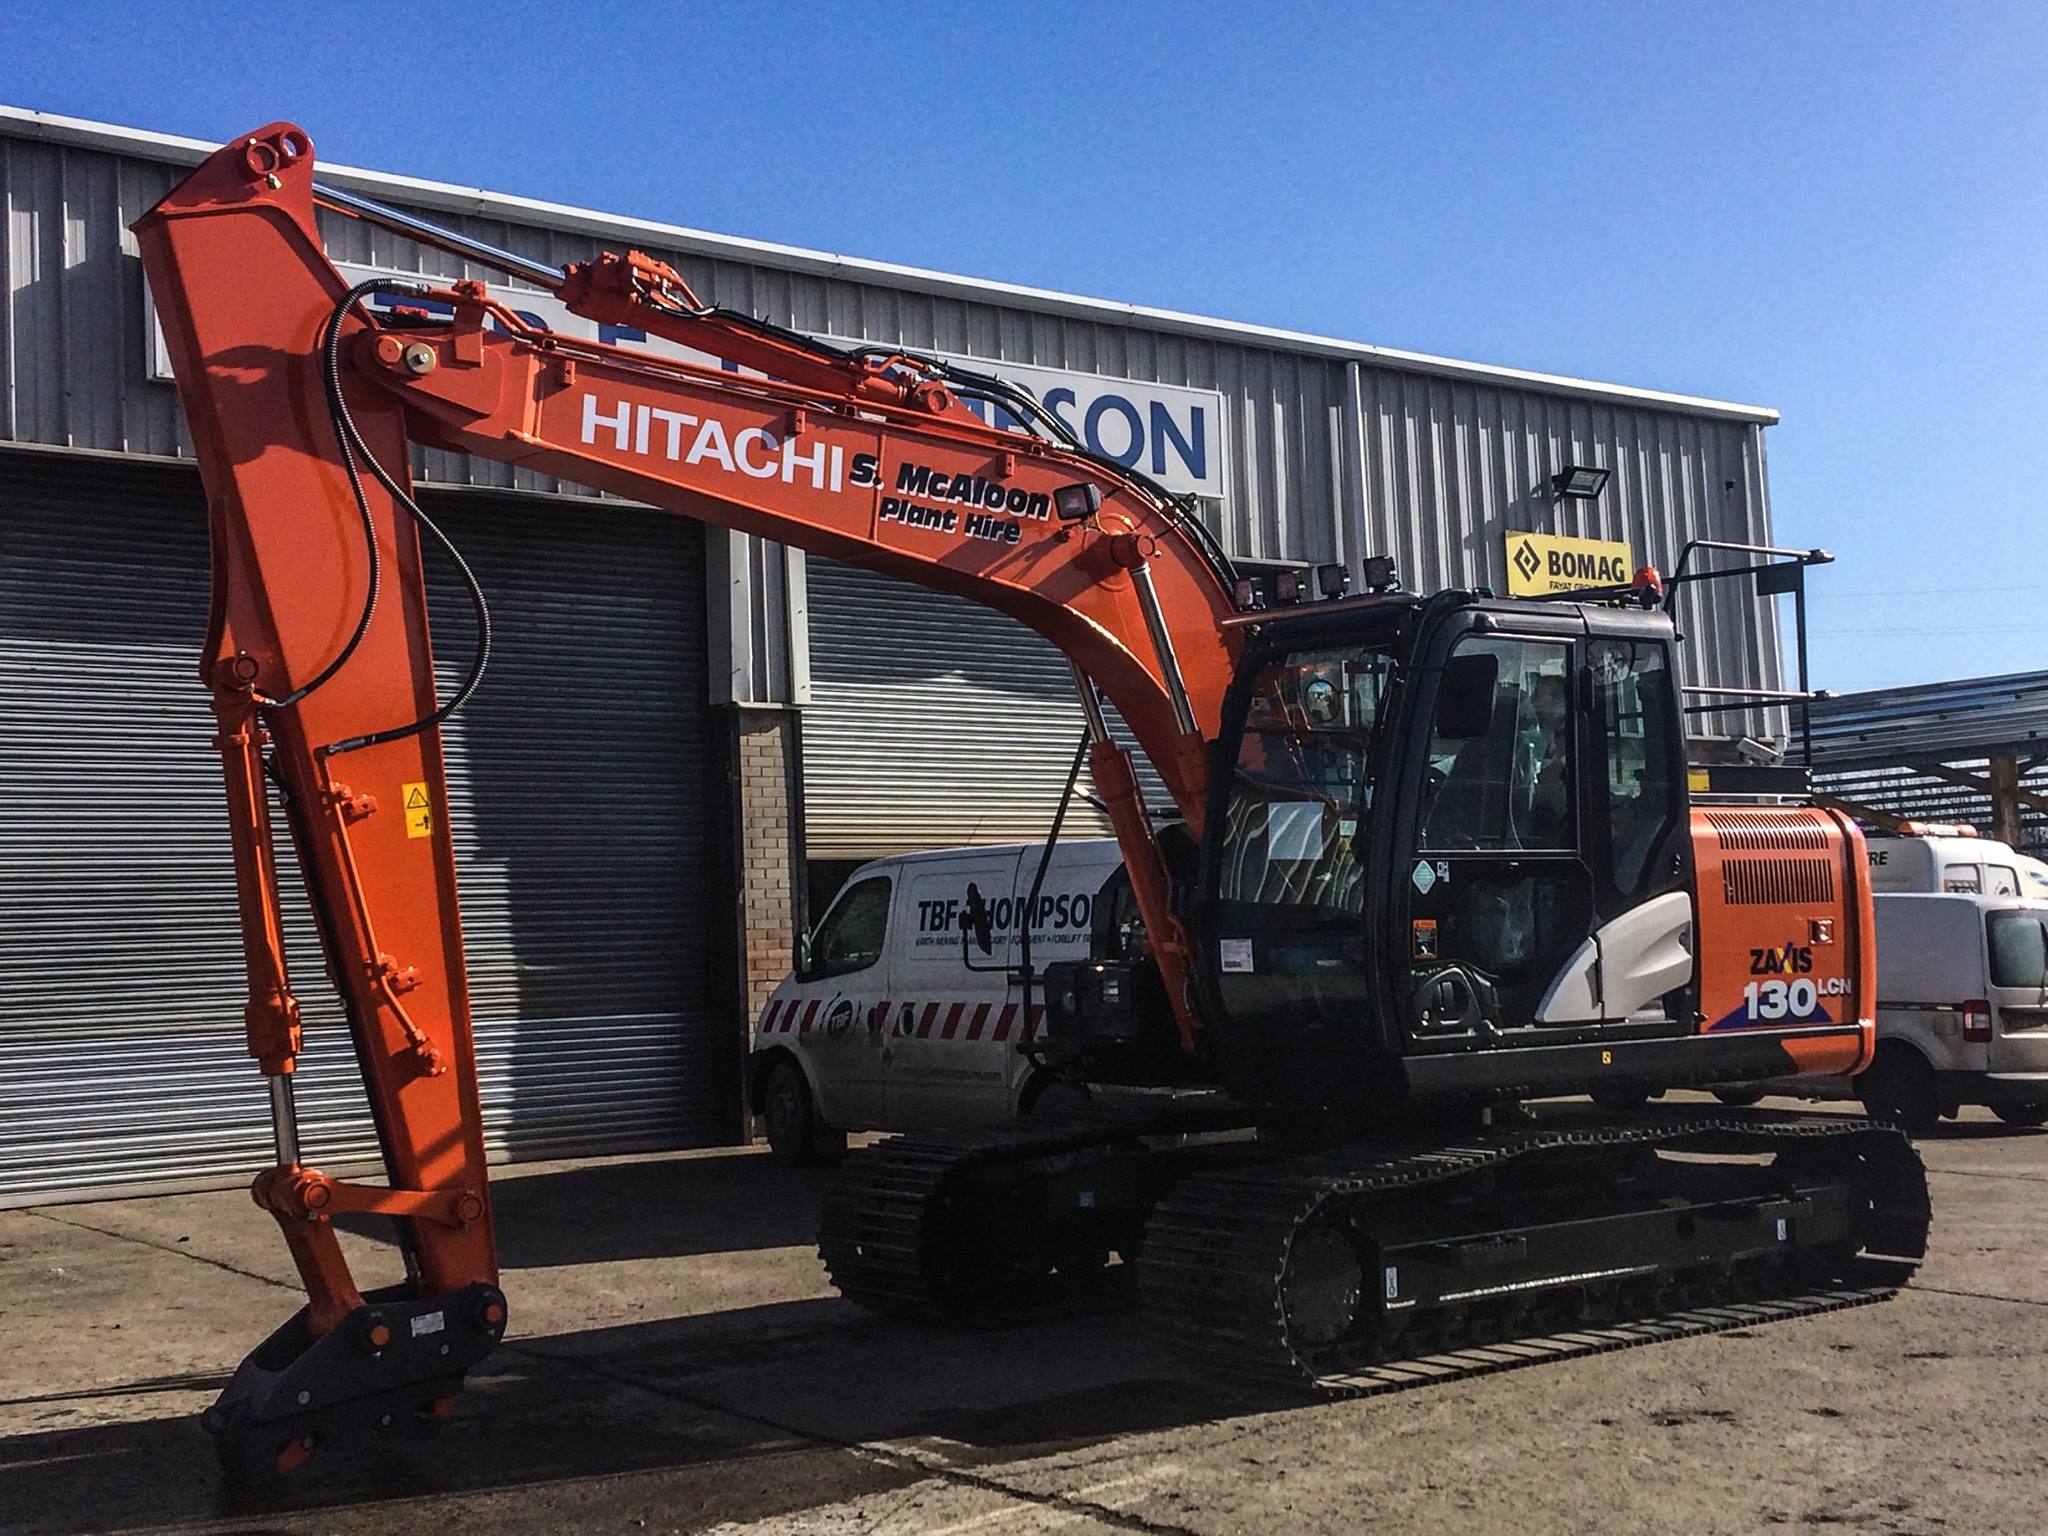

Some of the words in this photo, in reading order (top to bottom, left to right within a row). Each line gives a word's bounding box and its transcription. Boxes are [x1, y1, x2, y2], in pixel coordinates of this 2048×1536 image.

[580, 393, 844, 493] HITACHI
[848, 453, 885, 490] S.
[896, 462, 1053, 522] McAloon
[879, 497, 959, 533] Plant
[964, 513, 1022, 545] Hire
[1547, 550, 1625, 583] BOMAG
[1867, 851, 1888, 866] RE
[918, 899, 958, 931] TBF
[1750, 941, 1813, 975] ZAXIS
[1744, 978, 1818, 1021] 130
[1817, 977, 1852, 997] LCN
